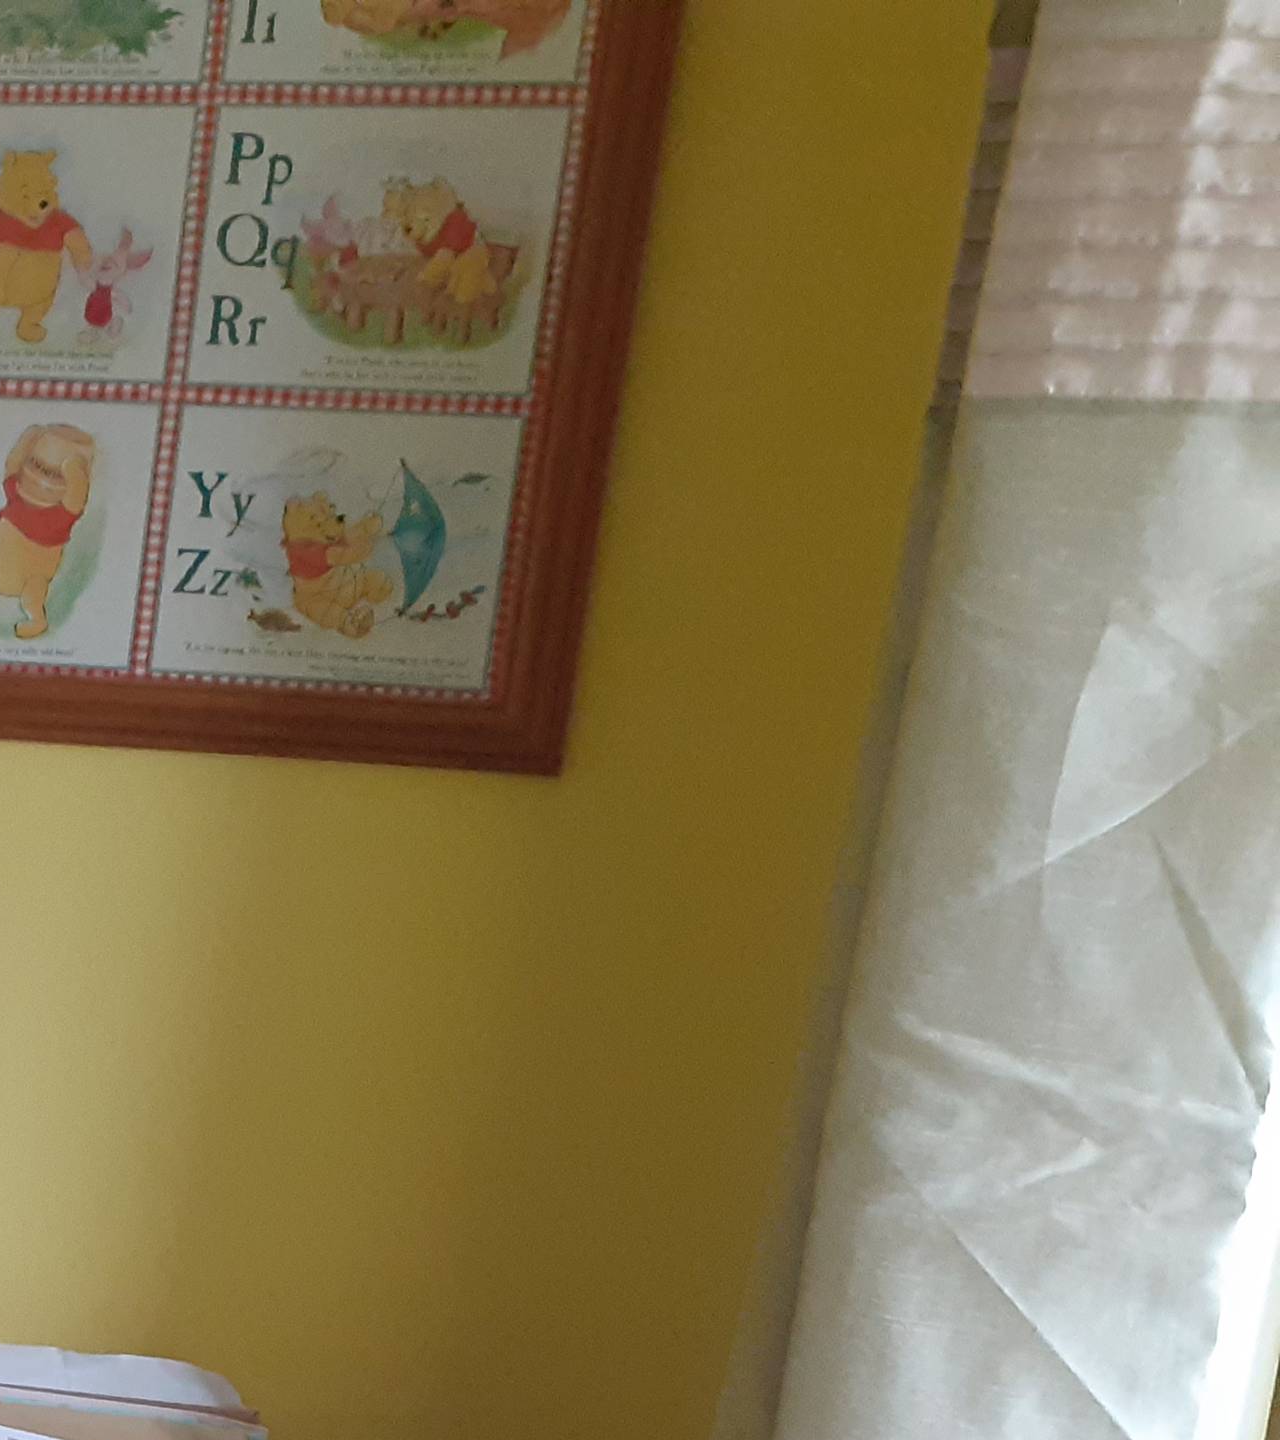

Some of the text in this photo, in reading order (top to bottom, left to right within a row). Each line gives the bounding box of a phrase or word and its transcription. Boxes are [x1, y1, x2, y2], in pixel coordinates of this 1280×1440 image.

[225, 132, 293, 206] Pp
[217, 213, 300, 291] Qq
[207, 294, 268, 347] Rr
[188, 470, 256, 537] Yy
[173, 547, 231, 597] Zz
